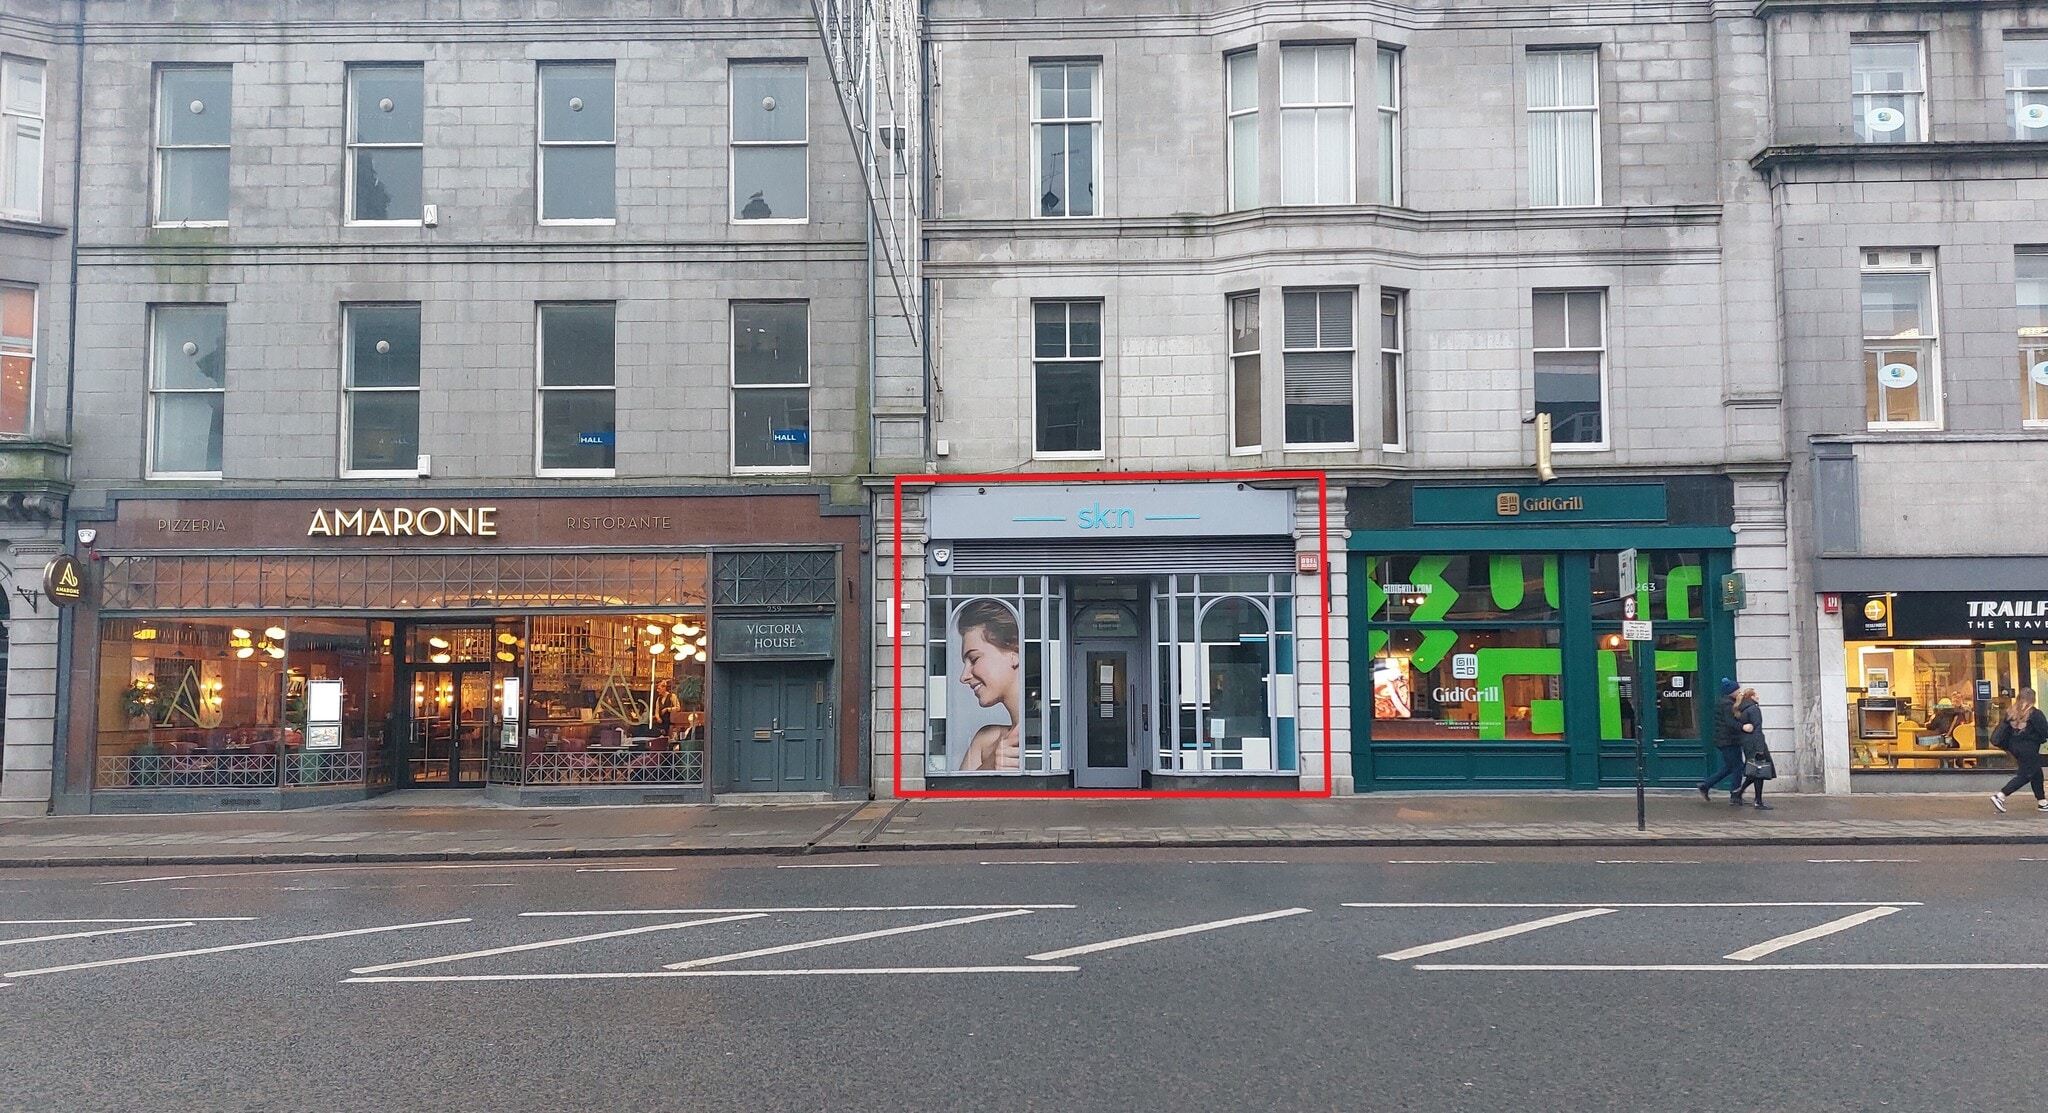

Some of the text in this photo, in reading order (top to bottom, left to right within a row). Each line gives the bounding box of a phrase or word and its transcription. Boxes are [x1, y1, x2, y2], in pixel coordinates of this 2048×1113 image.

[1078, 501, 1135, 529] sk:n
[158, 518, 227, 532] PIZZERIA
[307, 507, 497, 537] AMARONE
[567, 516, 671, 530] RISTORANTE
[56, 586, 80, 594] AMARONE
[1635, 582, 1656, 592] 263
[747, 624, 804, 634] VICTORIA
[1967, 621, 1994, 629] THE
[754, 638, 797, 648] HOUSE
